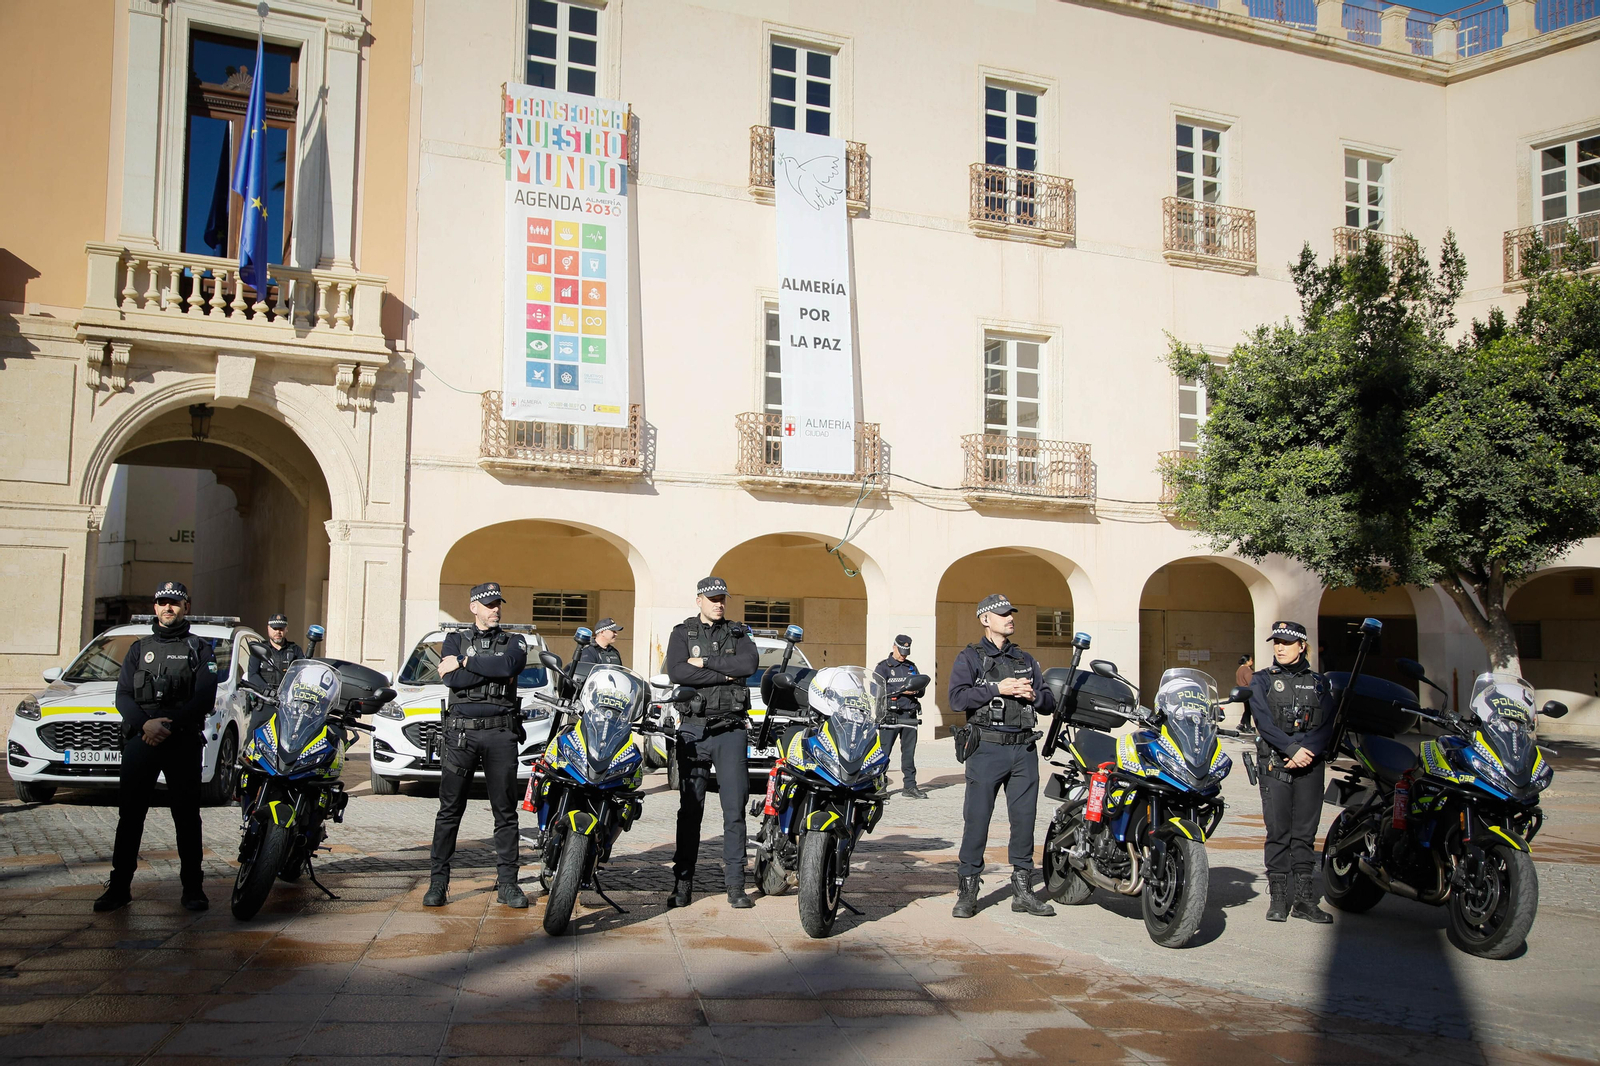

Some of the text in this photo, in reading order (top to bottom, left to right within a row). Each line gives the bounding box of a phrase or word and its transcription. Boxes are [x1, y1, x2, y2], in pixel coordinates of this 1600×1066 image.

[510, 97, 624, 131] TRANSFORMA
[511, 117, 622, 160] NUESTRO
[511, 149, 621, 195] MUNDO
[514, 189, 583, 212] AGENDA
[585, 196, 622, 206] ALMERÍA
[585, 202, 622, 217] 2030
[781, 277, 846, 296] ALMERÍA
[800, 307, 830, 322] POR
[790, 334, 841, 351] LA PAZ
[805, 418, 852, 430] ALMERÍA
[294, 691, 320, 703] LOCAL
[599, 697, 625, 710] LOCAL
[845, 698, 871, 711] LOCAL
[1177, 690, 1212, 708] POLICIA
[1181, 701, 1208, 715] LOCAL
[1491, 697, 1529, 715] POLICIA
[1498, 707, 1528, 721] LOCAL
[73, 751, 100, 762] 3930
[753, 748, 775, 757] 3929
